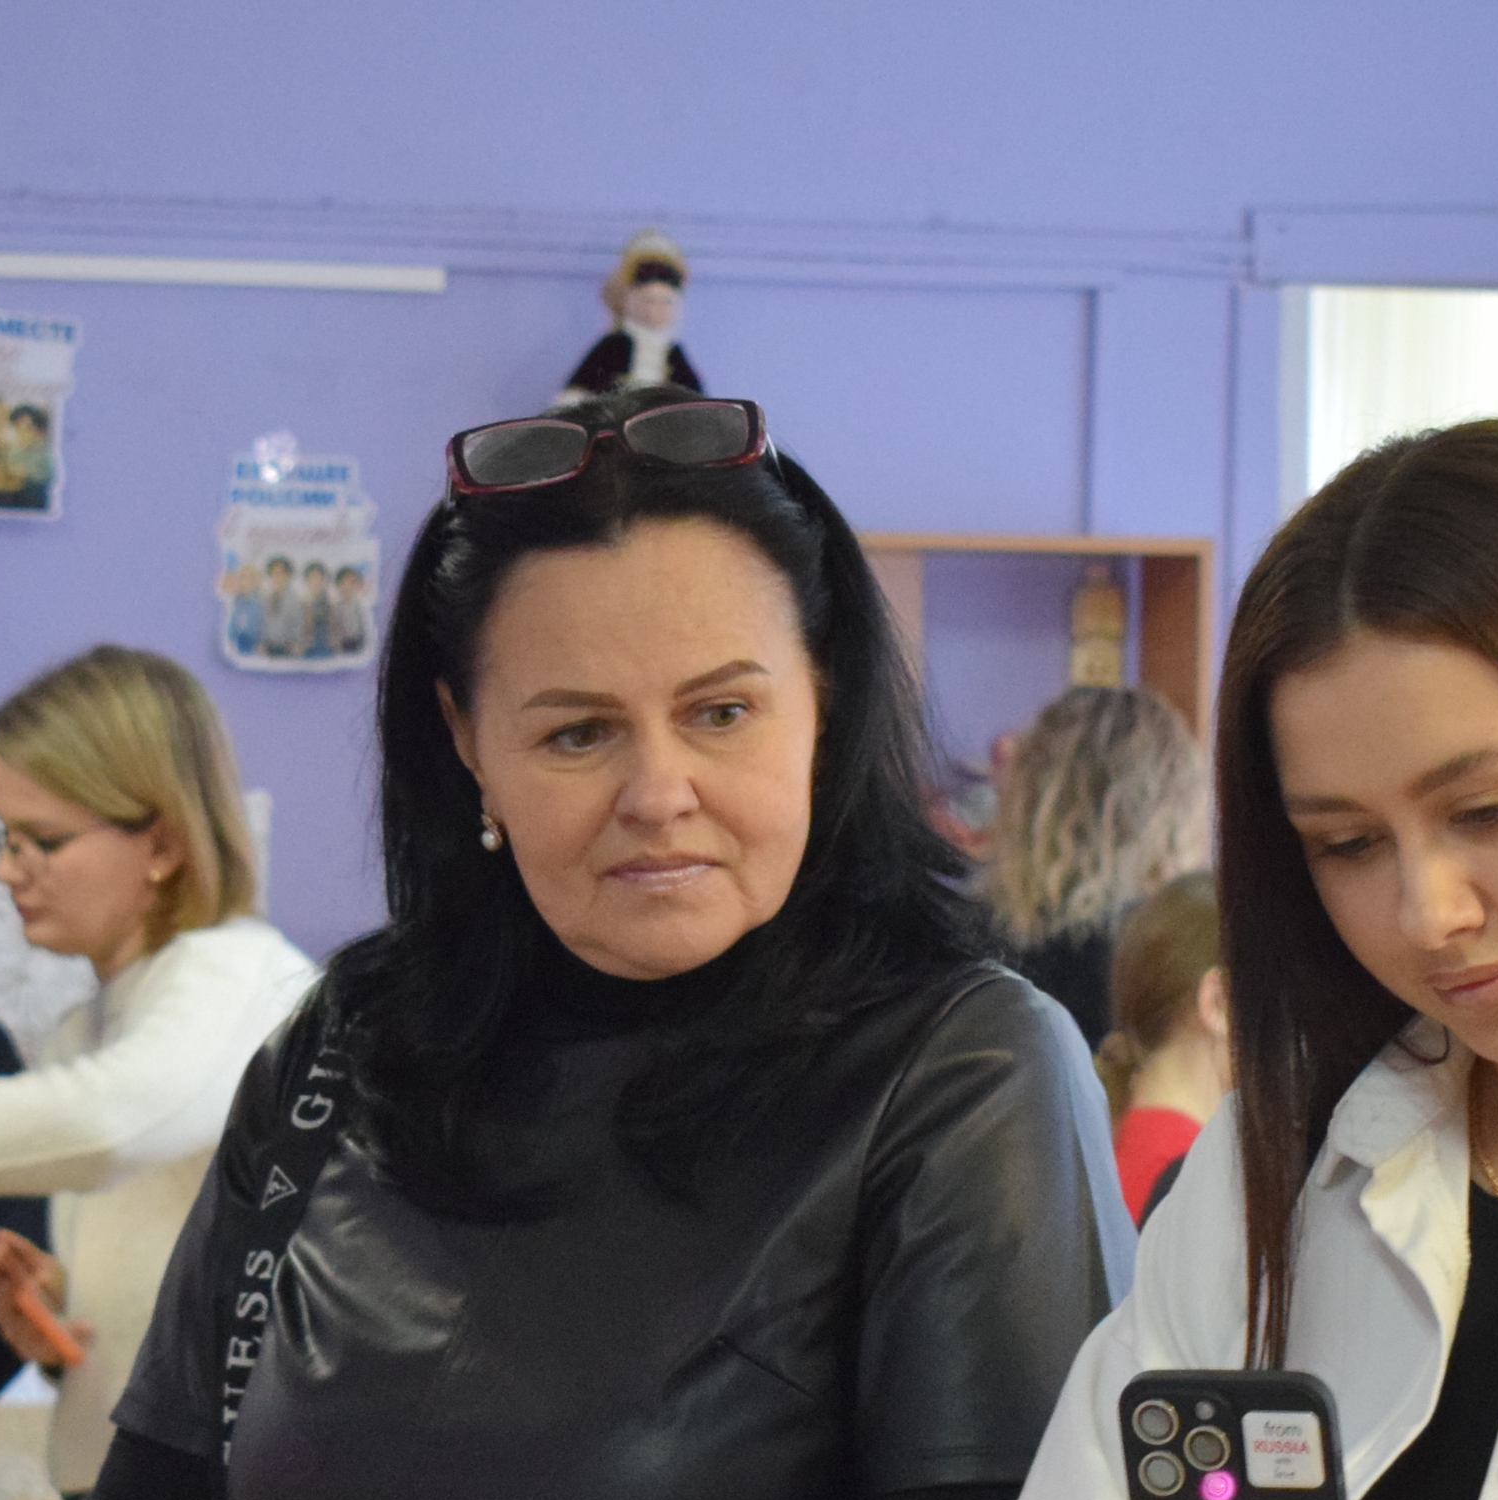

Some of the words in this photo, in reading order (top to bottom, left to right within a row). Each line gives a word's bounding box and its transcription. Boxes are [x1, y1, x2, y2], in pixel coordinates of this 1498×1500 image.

[222, 1249, 275, 1467] UESS
[1263, 1421, 1303, 1438] from
[1253, 1440, 1311, 1455] RUSSIA
